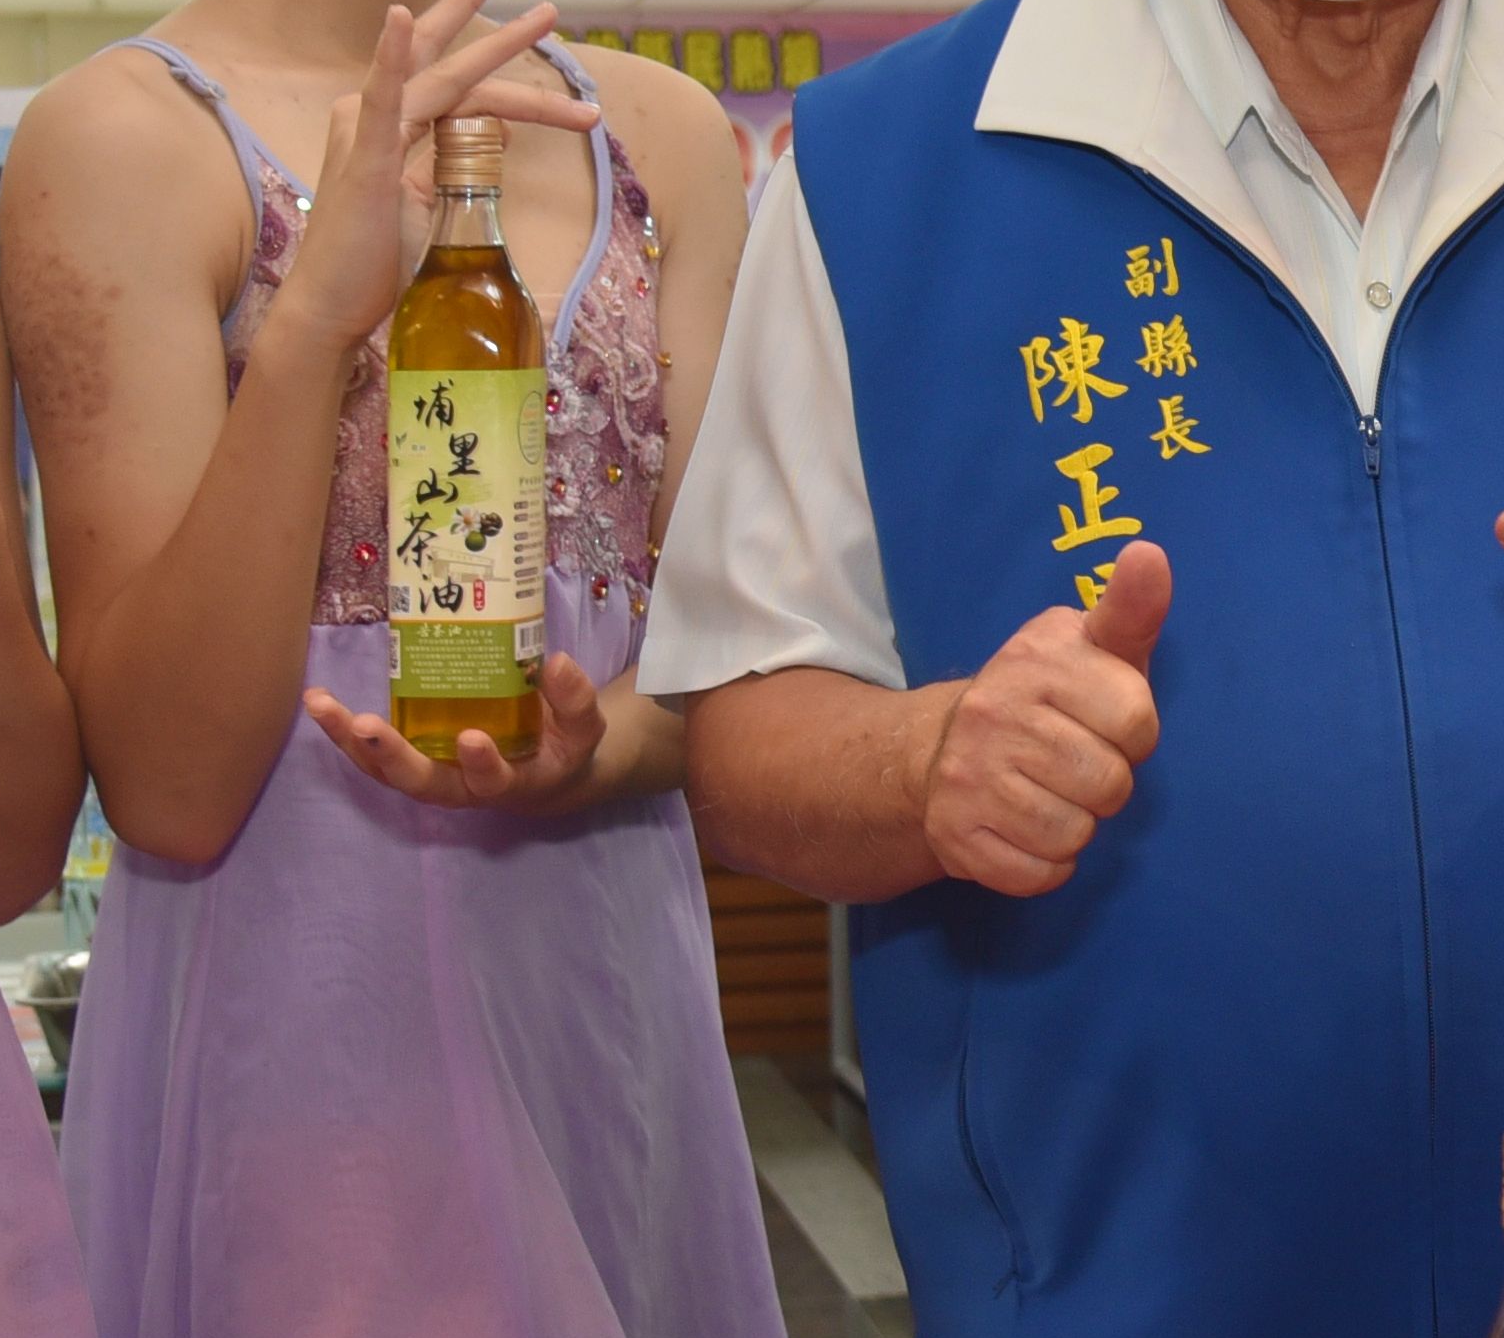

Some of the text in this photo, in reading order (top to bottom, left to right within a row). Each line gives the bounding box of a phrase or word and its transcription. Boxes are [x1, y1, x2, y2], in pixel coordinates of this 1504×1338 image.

[1123, 237, 1212, 461] 副縣長
[396, 378, 481, 615] 埔里山茶油
